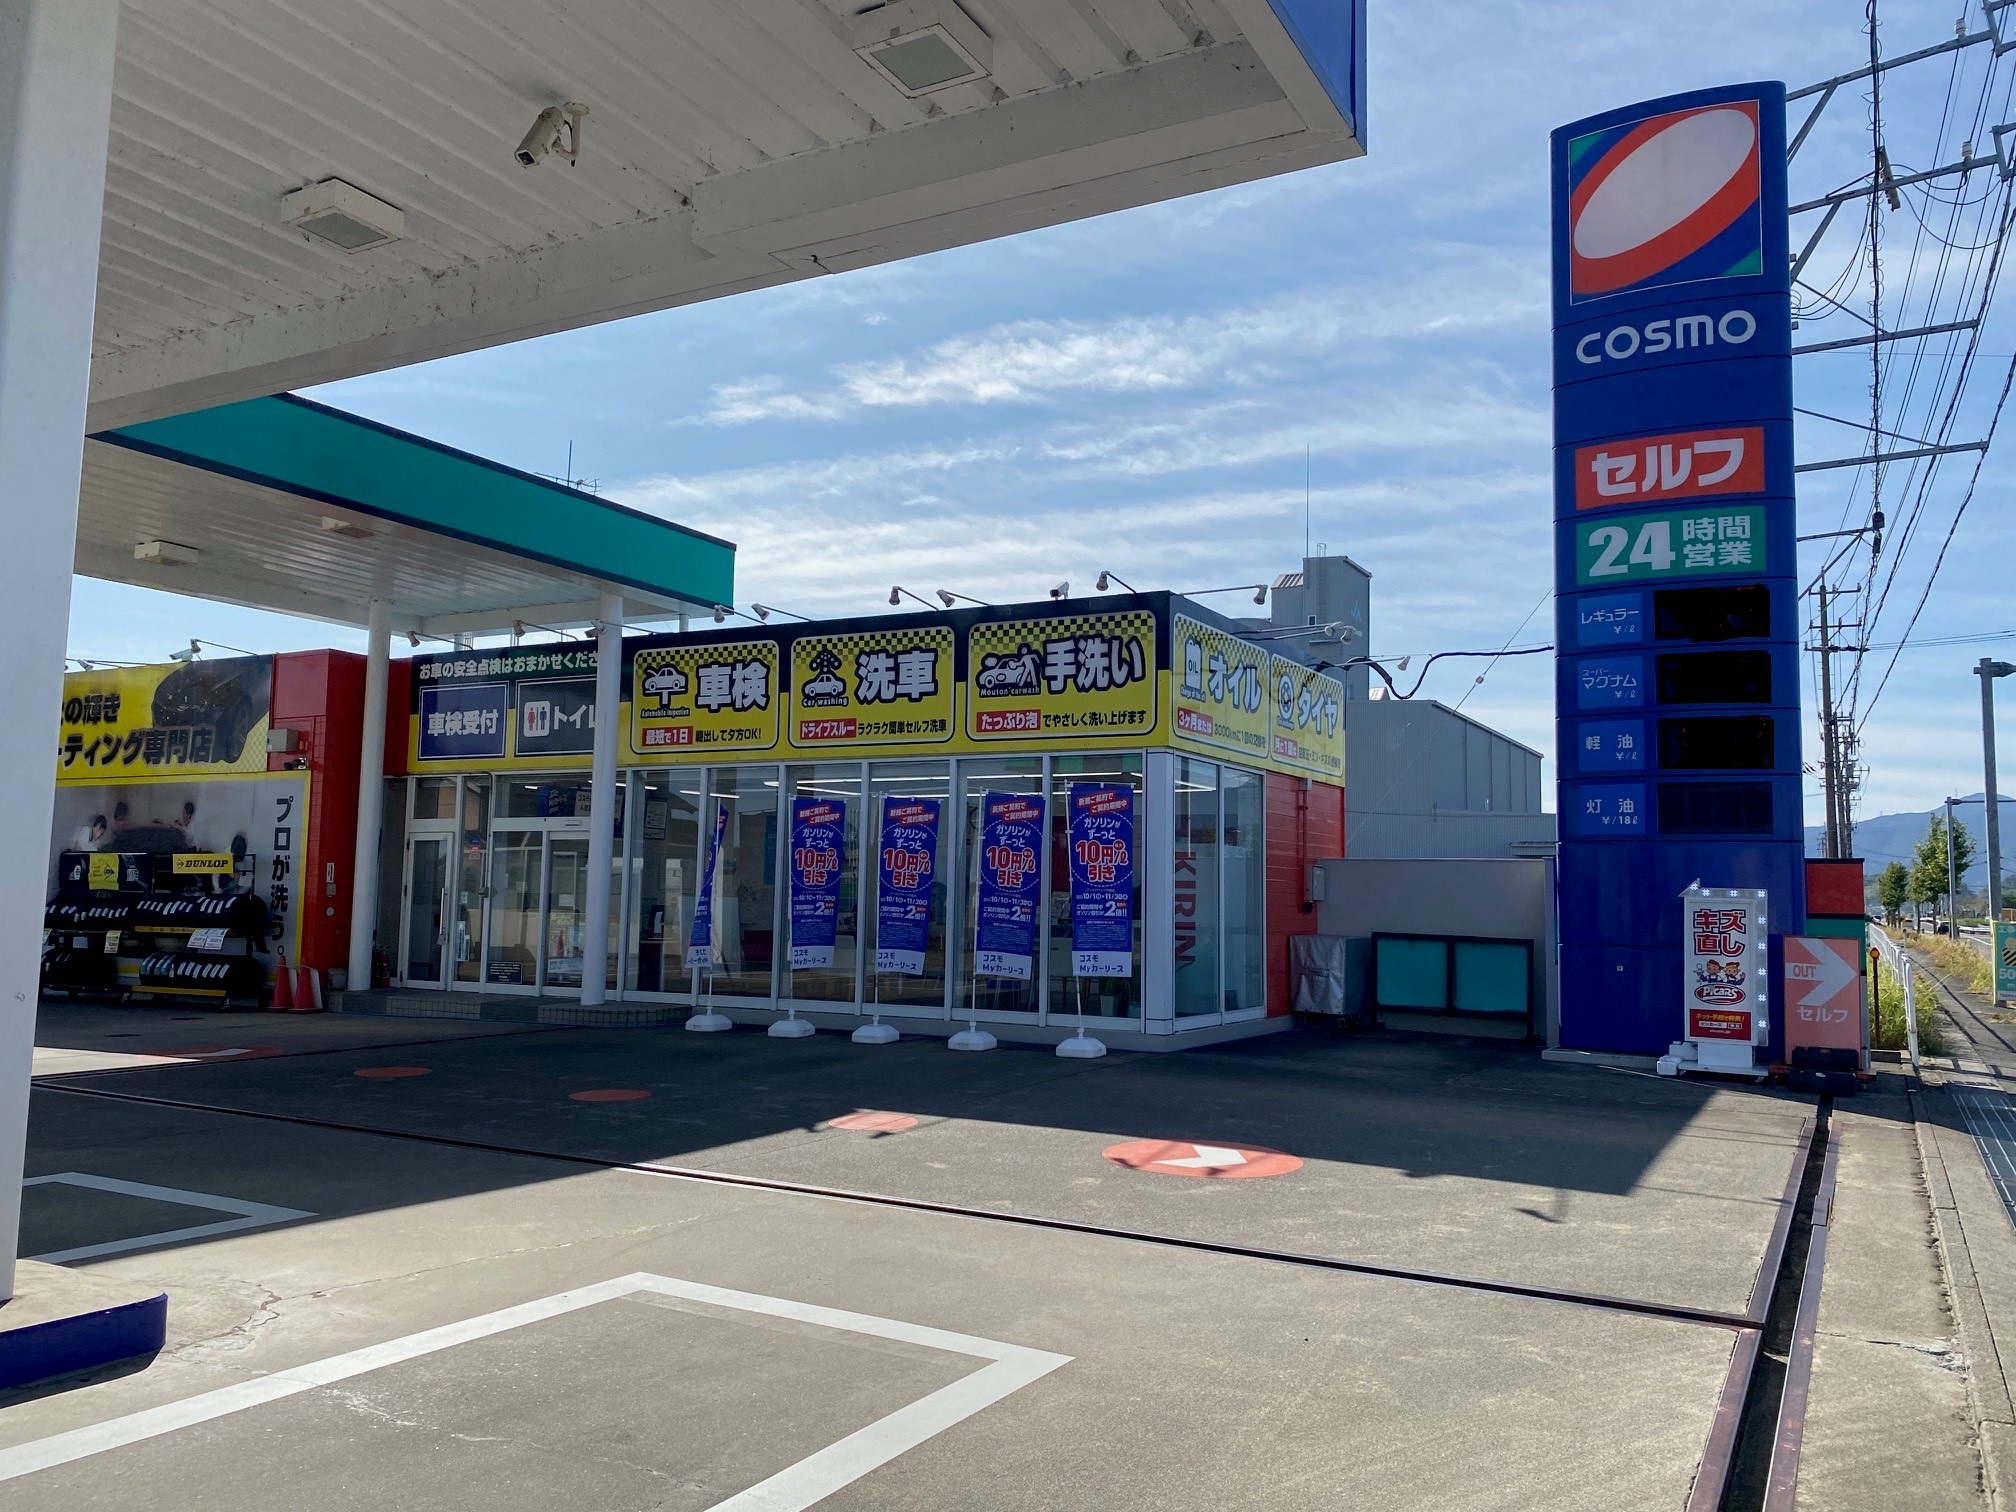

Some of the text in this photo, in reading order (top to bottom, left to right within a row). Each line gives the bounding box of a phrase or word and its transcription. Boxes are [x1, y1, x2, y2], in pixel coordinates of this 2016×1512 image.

[1576, 310, 1756, 364] COSMO
[1591, 438, 1744, 496] セルフ
[1589, 515, 1750, 577] 24 時間
[1682, 541, 1752, 568] 営業
[1581, 608, 1639, 624] レギュラー
[1045, 637, 1144, 692] 手洗い
[1188, 659, 1199, 674] OIL
[857, 650, 936, 701] 洗車
[1208, 653, 1262, 712] オイル
[1582, 675, 1638, 690] マグナム
[697, 660, 769, 711] 車検
[981, 686, 1040, 697] Mouton carwash
[803, 697, 848, 707] Car washing
[981, 710, 1147, 730] たっぷり泡 でやさしく洗い上げます
[1298, 687, 1339, 738] タイヤ
[427, 709, 498, 736] 車検受付
[801, 719, 948, 738] ドライブスルー ラクラク簡単セルフ洗車
[645, 727, 689, 745] 最短で1日
[996, 824, 1030, 837] ガソリンが
[1084, 818, 1121, 829] ガソリンが
[802, 828, 834, 838] ガソリンが
[893, 828, 927, 839] ガソリンが
[184, 860, 229, 869] DUNLOP
[1088, 863, 1116, 882] 引き
[804, 870, 828, 886] 引き
[893, 871, 919, 888] 引き
[997, 869, 1023, 888] 引き
[1175, 851, 1196, 973] KIRIN
[1694, 910, 1747, 933] キズ
[794, 949, 808, 957] コスモ
[1694, 933, 1746, 957] 直し
[878, 952, 895, 960] コスモ
[983, 954, 1003, 963] コスモ
[1080, 954, 1099, 962] コスモ
[983, 964, 1025, 975] Myカーリース
[1080, 964, 1124, 973] Myカーリース
[1792, 964, 1817, 978] OUT
[1797, 1008, 1849, 1023] セルフ
